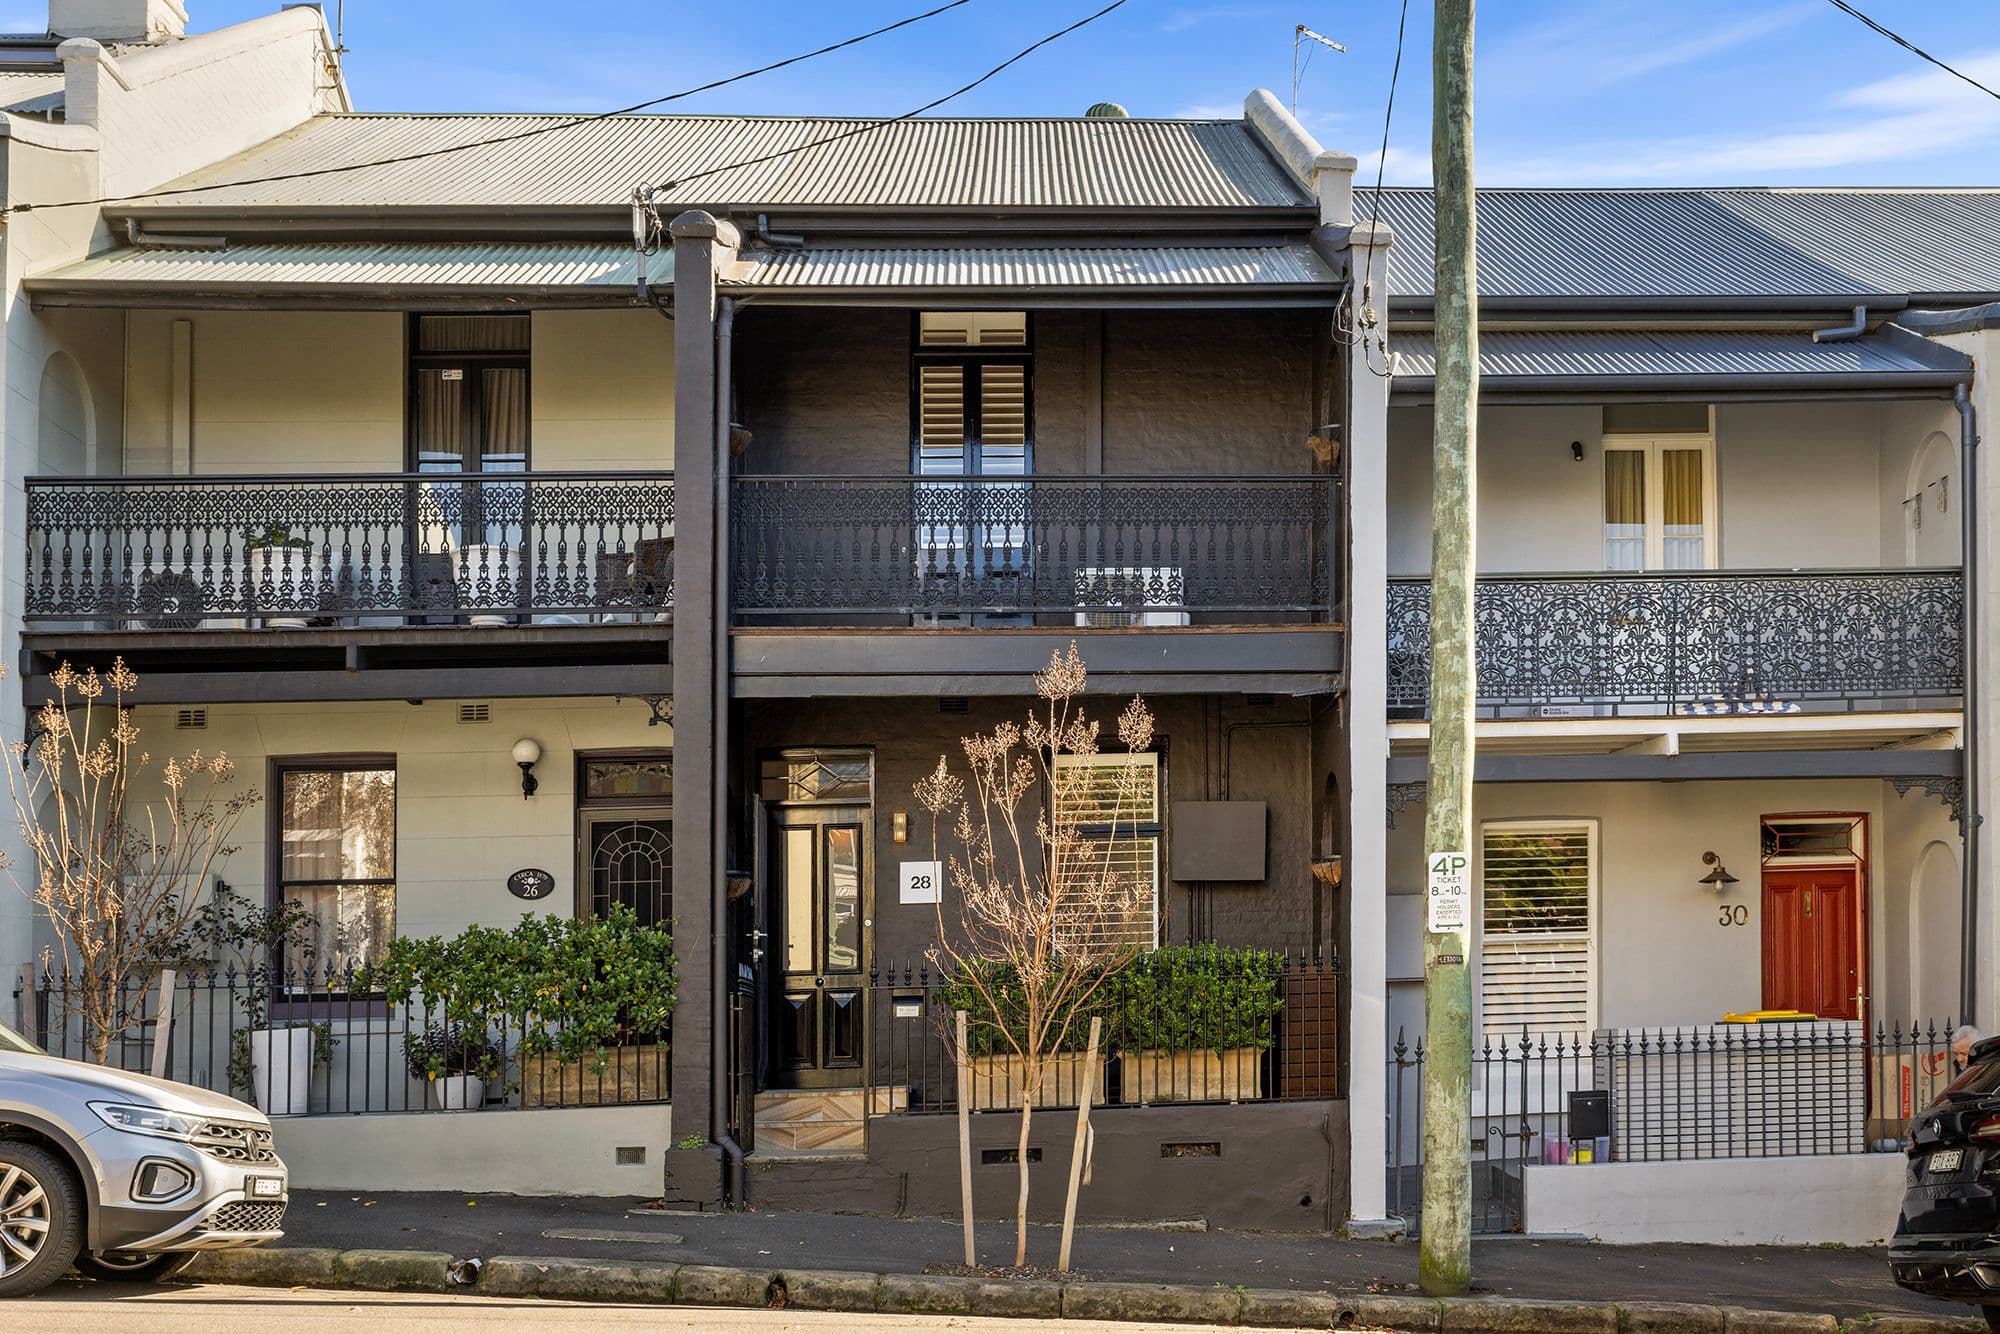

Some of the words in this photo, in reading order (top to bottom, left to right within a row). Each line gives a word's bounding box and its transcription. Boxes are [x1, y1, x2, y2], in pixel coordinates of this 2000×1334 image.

[1432, 857, 1466, 875] 4P
[513, 871, 534, 880] CIRCA
[911, 876, 931, 889] 28
[523, 885, 538, 896] 26
[1719, 905, 1748, 926] 30
